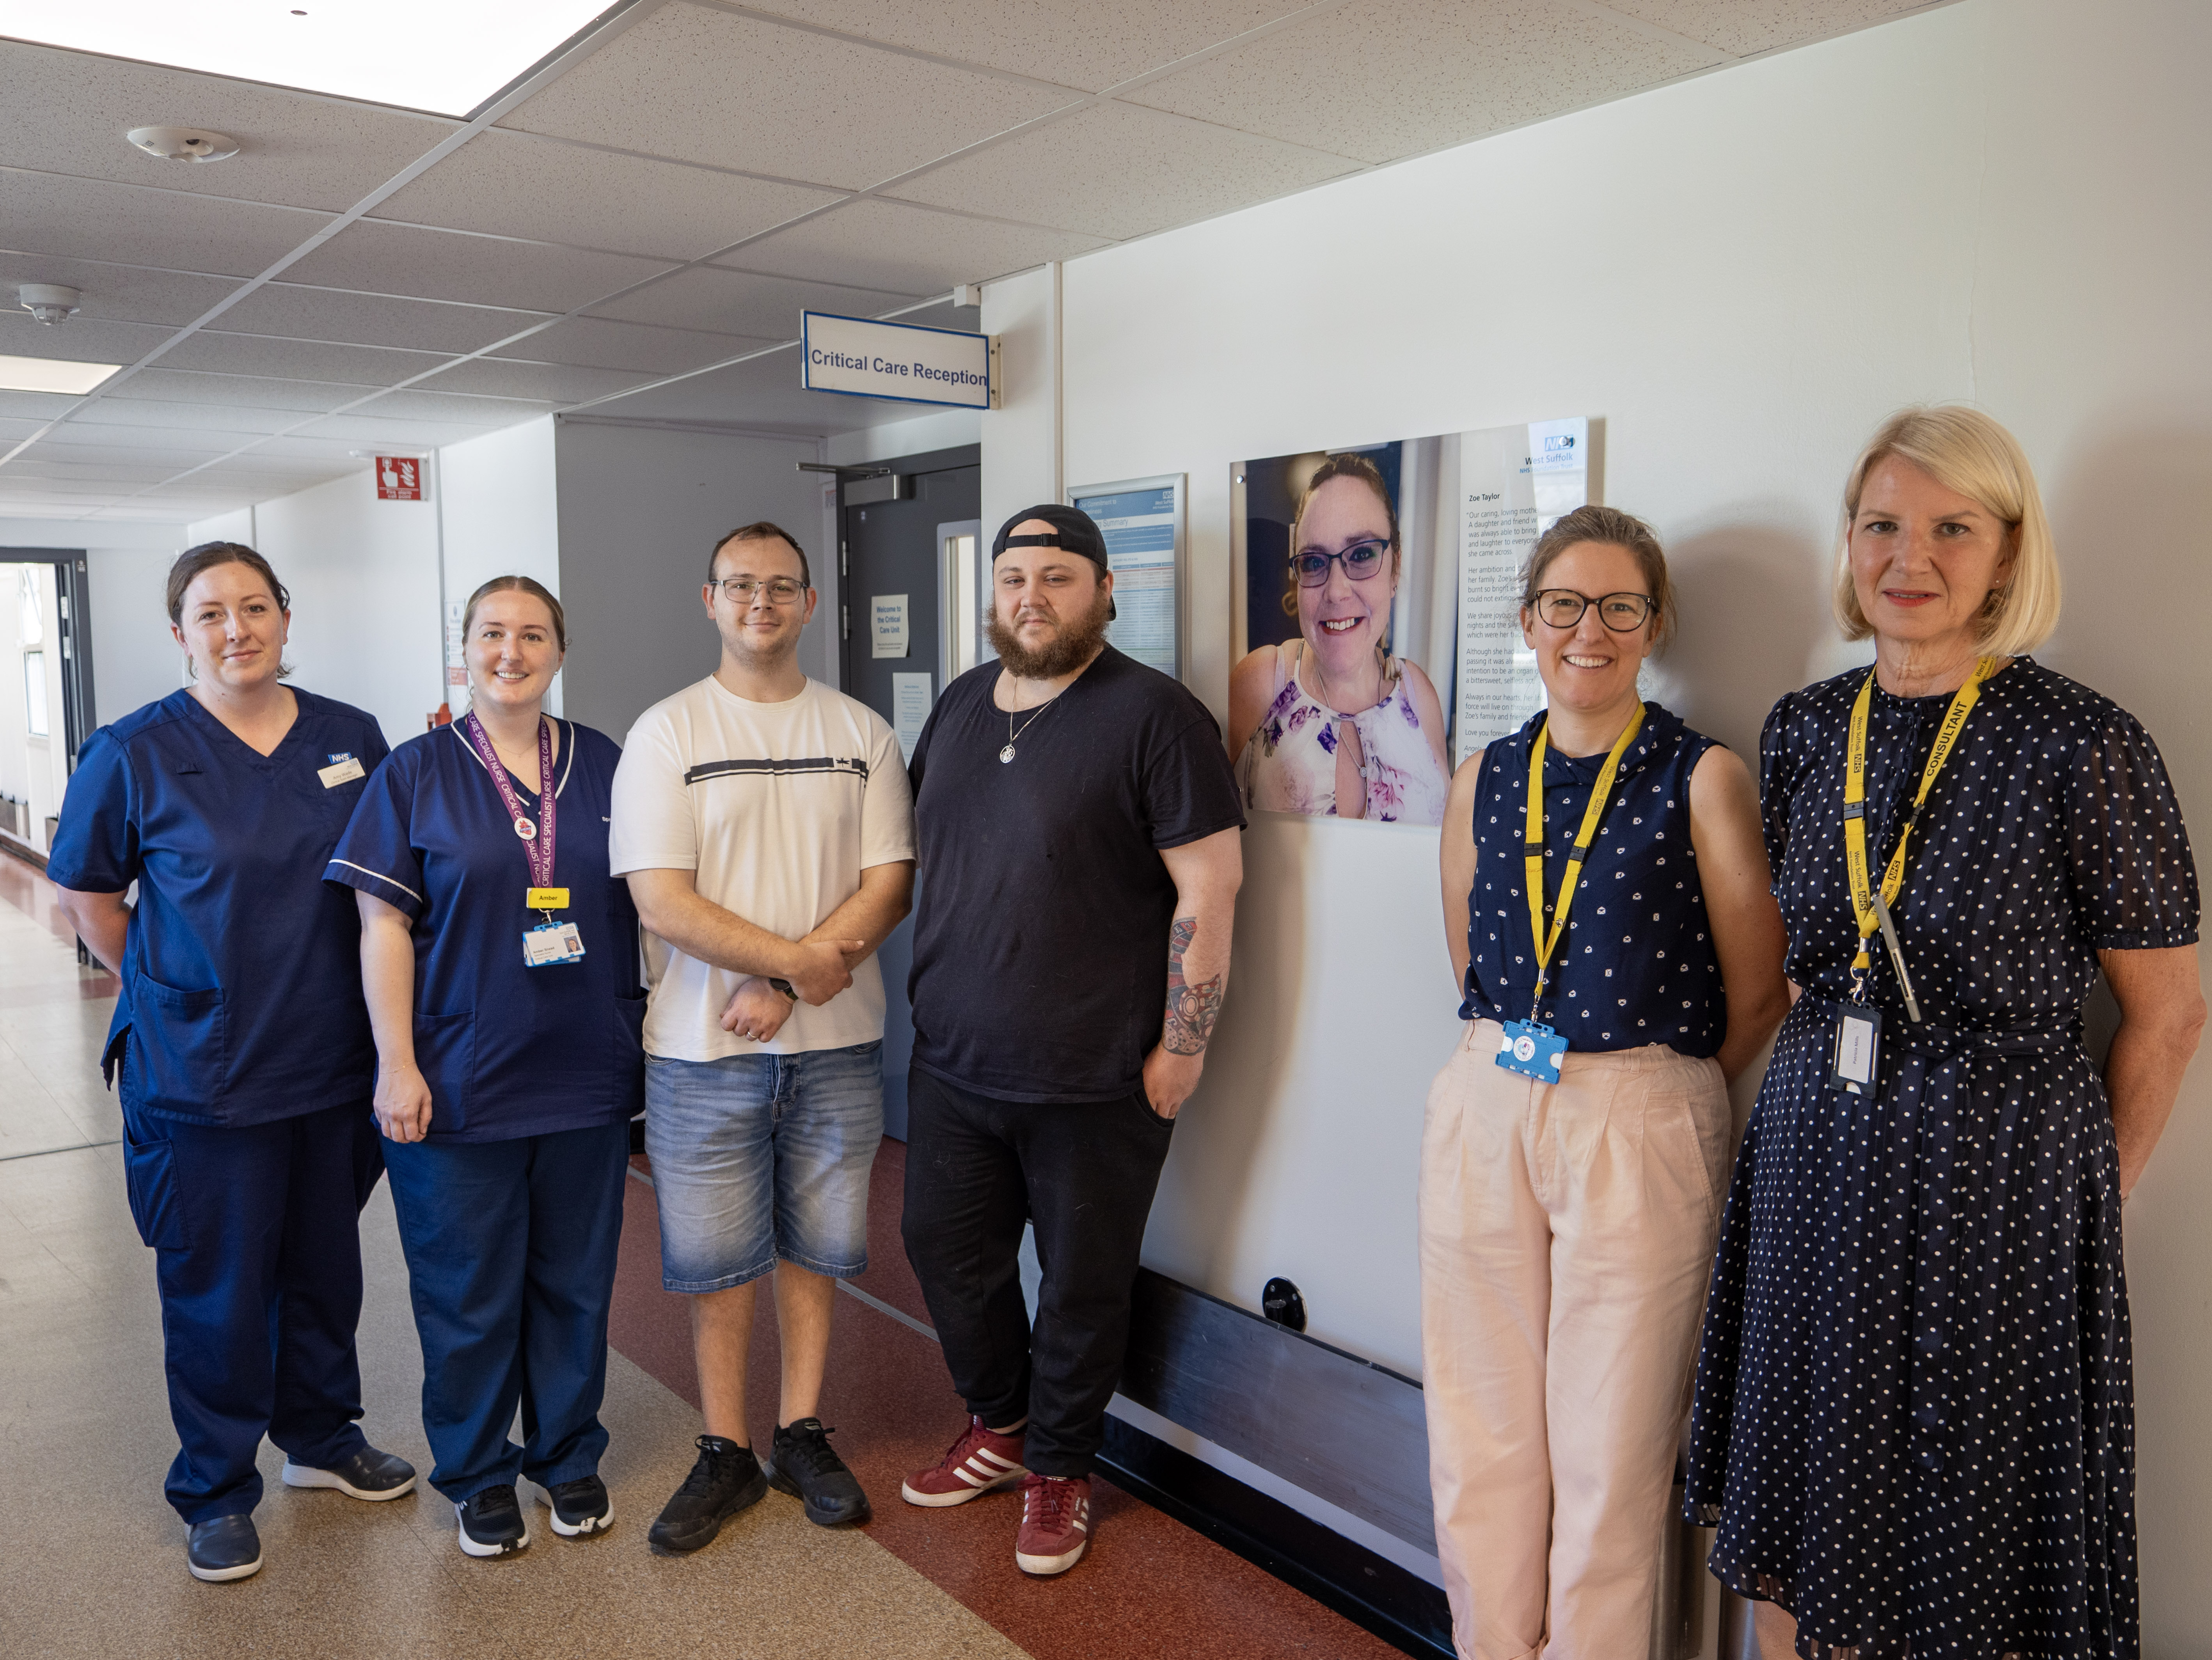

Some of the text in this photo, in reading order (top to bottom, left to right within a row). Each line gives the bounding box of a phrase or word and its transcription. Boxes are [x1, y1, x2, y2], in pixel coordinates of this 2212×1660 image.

[811, 349, 987, 386] Critical Care Reception
[1546, 452, 1573, 463] Suffolk
[1482, 493, 1500, 502] Taylor
[1474, 520, 1499, 529] daughter
[1481, 539, 1502, 548] laughter
[1467, 622, 1483, 630] nights
[1975, 665, 1985, 677] West
[1465, 693, 1484, 701] Always
[1511, 704, 1533, 713] through
[1480, 713, 1496, 721] family
[1927, 701, 1967, 776] CONSULTANT
[332, 754, 349, 762] NHS
[469, 716, 480, 732] CARE
[475, 731, 496, 761] SPECIALIST
[490, 762, 506, 783] NURSE
[501, 784, 518, 810] CRITICAL
[1600, 778, 1609, 796] Suffolk
[1593, 799, 1604, 816] NHS
[544, 802, 552, 835] SPECIALIST
[542, 857, 550, 886] CRITICAL
[1888, 860, 1900, 881] NHS
[1858, 891, 1868, 911] NHS
